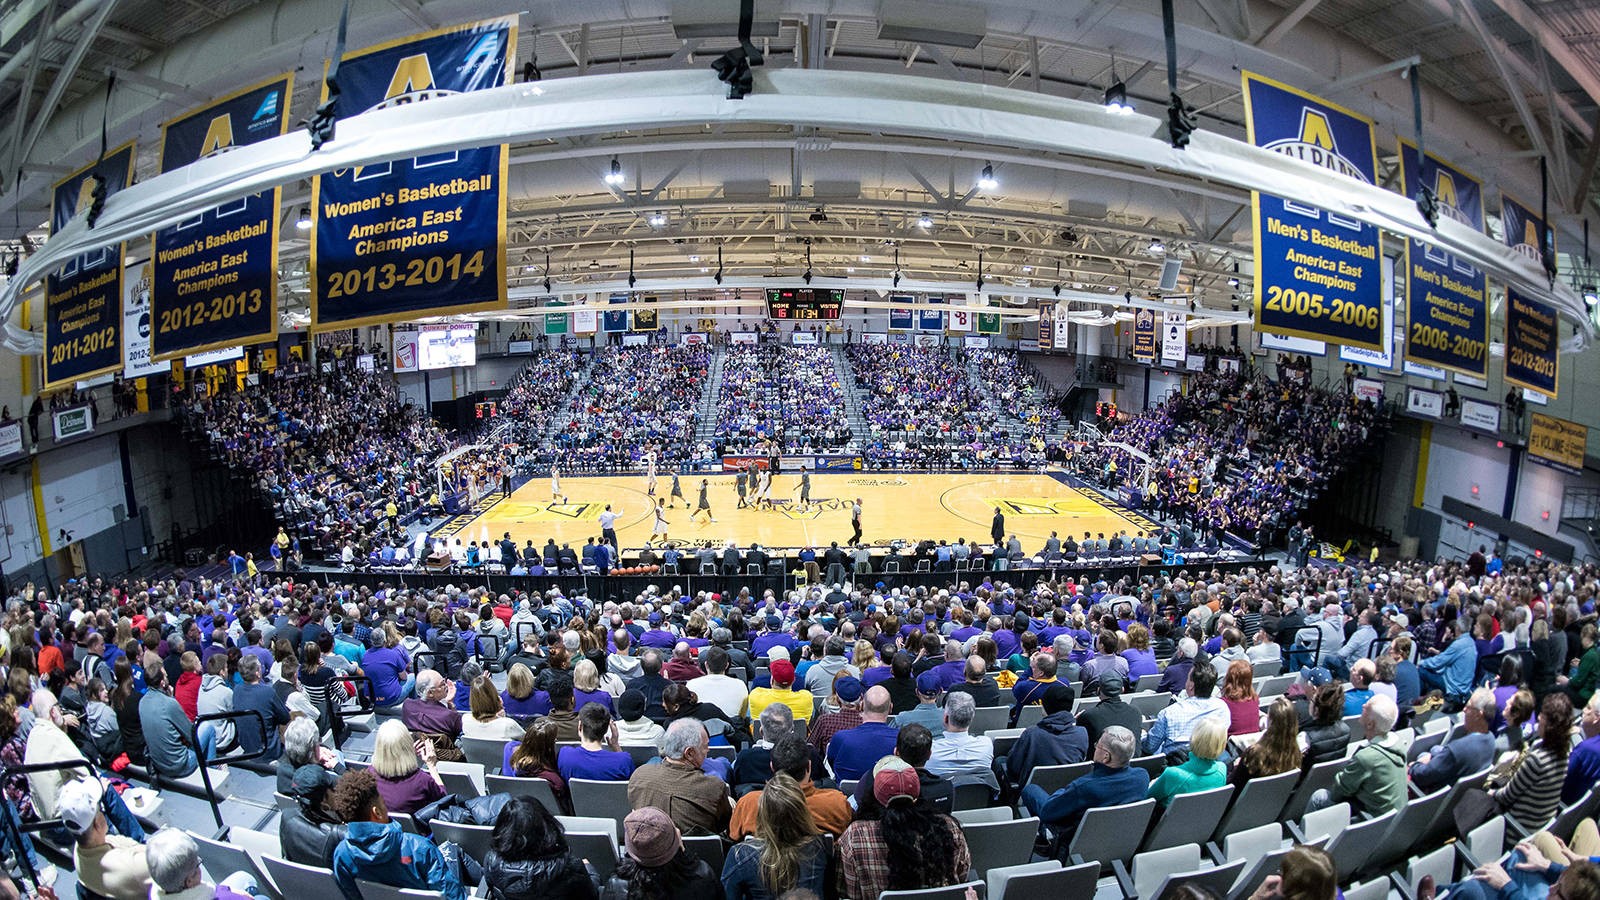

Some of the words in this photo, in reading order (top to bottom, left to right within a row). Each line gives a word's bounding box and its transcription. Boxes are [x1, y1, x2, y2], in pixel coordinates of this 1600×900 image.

[325, 192, 395, 219] Women's
[398, 174, 492, 204] Basketball
[348, 216, 416, 240] America
[422, 206, 463, 227] East
[1267, 217, 1308, 242] Men's
[1311, 229, 1375, 260] Basketball
[158, 240, 203, 264] Women's
[206, 219, 268, 249] Basketball
[355, 229, 449, 256] Champions
[173, 260, 218, 282] America
[221, 250, 248, 269] East
[327, 250, 485, 299] 2013-2014
[1286, 248, 1336, 272] America
[1339, 260, 1362, 278] East
[1294, 266, 1357, 292] Champions
[49, 286, 78, 305] Women's
[79, 268, 117, 293] Basketball
[177, 271, 238, 296] Champions
[1414, 264, 1441, 285] Men's
[1442, 275, 1483, 302] Basketball
[59, 304, 87, 321] America
[88, 295, 105, 309] East
[160, 289, 262, 333] 2012-2013
[778, 309, 787, 317] 16
[795, 309, 818, 319] 11:34
[829, 309, 838, 318] 11
[1265, 285, 1379, 330] 2005-2006
[1425, 291, 1458, 312] America
[1459, 303, 1475, 317] East
[1430, 307, 1470, 329] Champions
[62, 313, 100, 333] Champions
[51, 327, 115, 365] 2011-2012
[129, 349, 151, 361] 2012-2
[1411, 322, 1485, 361] 2006-2007
[1510, 346, 1555, 378] 2012-2013
